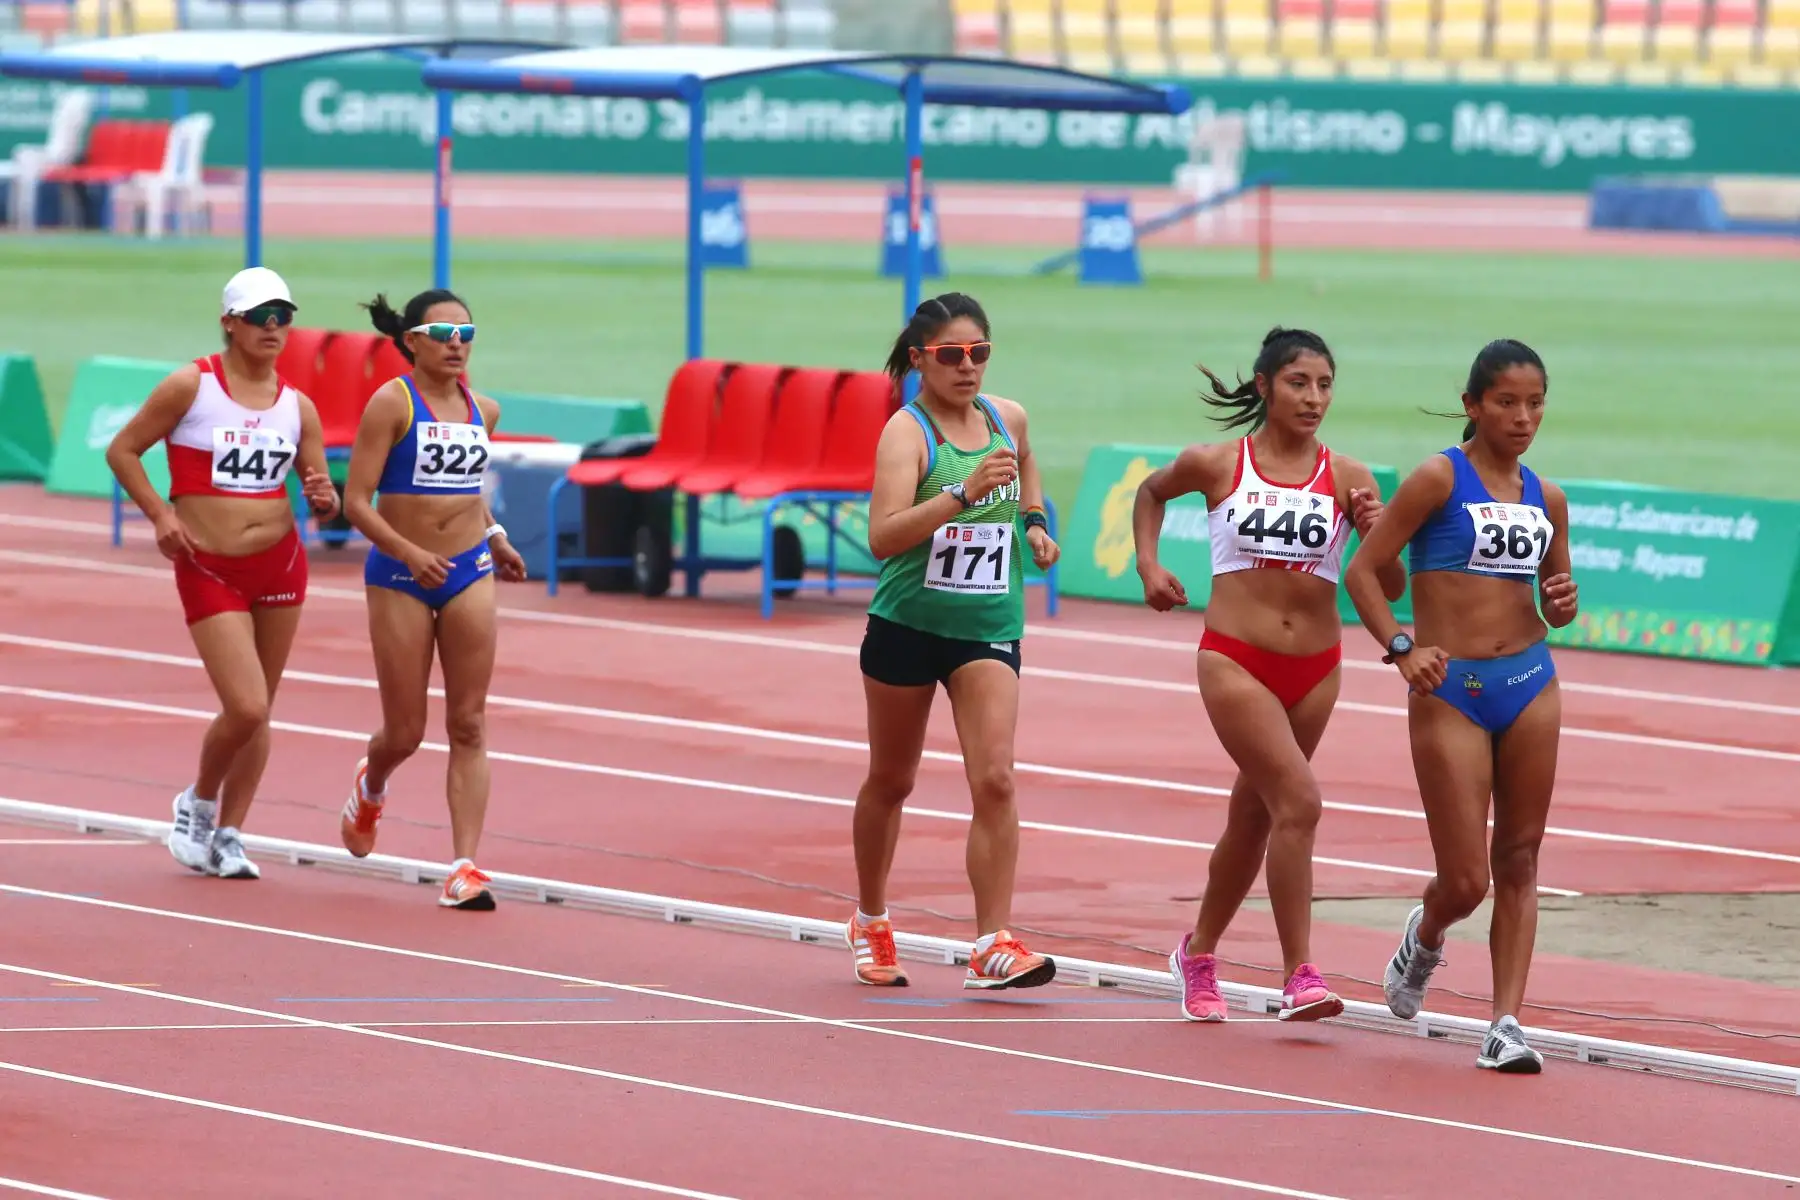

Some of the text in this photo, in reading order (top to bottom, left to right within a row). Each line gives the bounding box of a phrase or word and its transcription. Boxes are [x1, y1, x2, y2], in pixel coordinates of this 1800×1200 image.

[302, 78, 649, 145] Campeonato
[655, 87, 1050, 147] Sudamercano
[1451, 101, 1694, 167] Mayores
[217, 448, 291, 481] 447
[420, 443, 488, 475] 322
[1238, 508, 1327, 548] 446
[1478, 524, 1547, 561] 361
[935, 545, 1004, 581] 171
